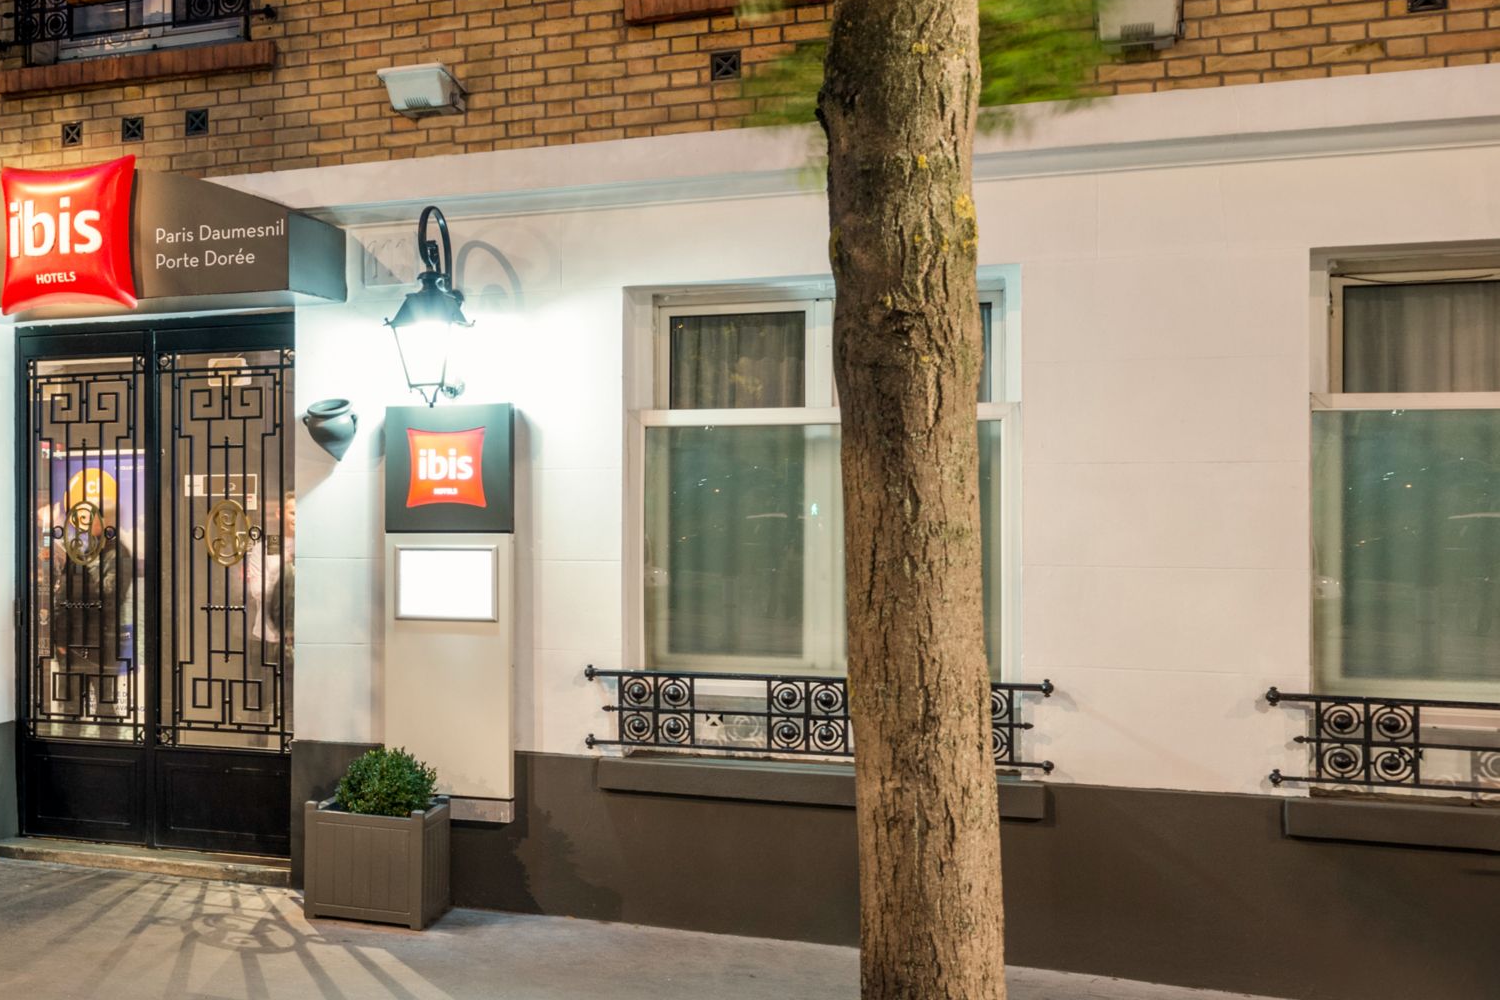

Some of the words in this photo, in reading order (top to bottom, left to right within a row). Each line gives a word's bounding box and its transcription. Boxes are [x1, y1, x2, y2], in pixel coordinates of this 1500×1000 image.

[9, 197, 103, 258] ibis
[155, 228, 194, 244] Paris
[199, 218, 285, 242] Daumesnil
[155, 253, 200, 270] Porte
[204, 248, 256, 267] Dorée
[36, 271, 77, 285] HOTELS
[418, 448, 474, 480] ibis
